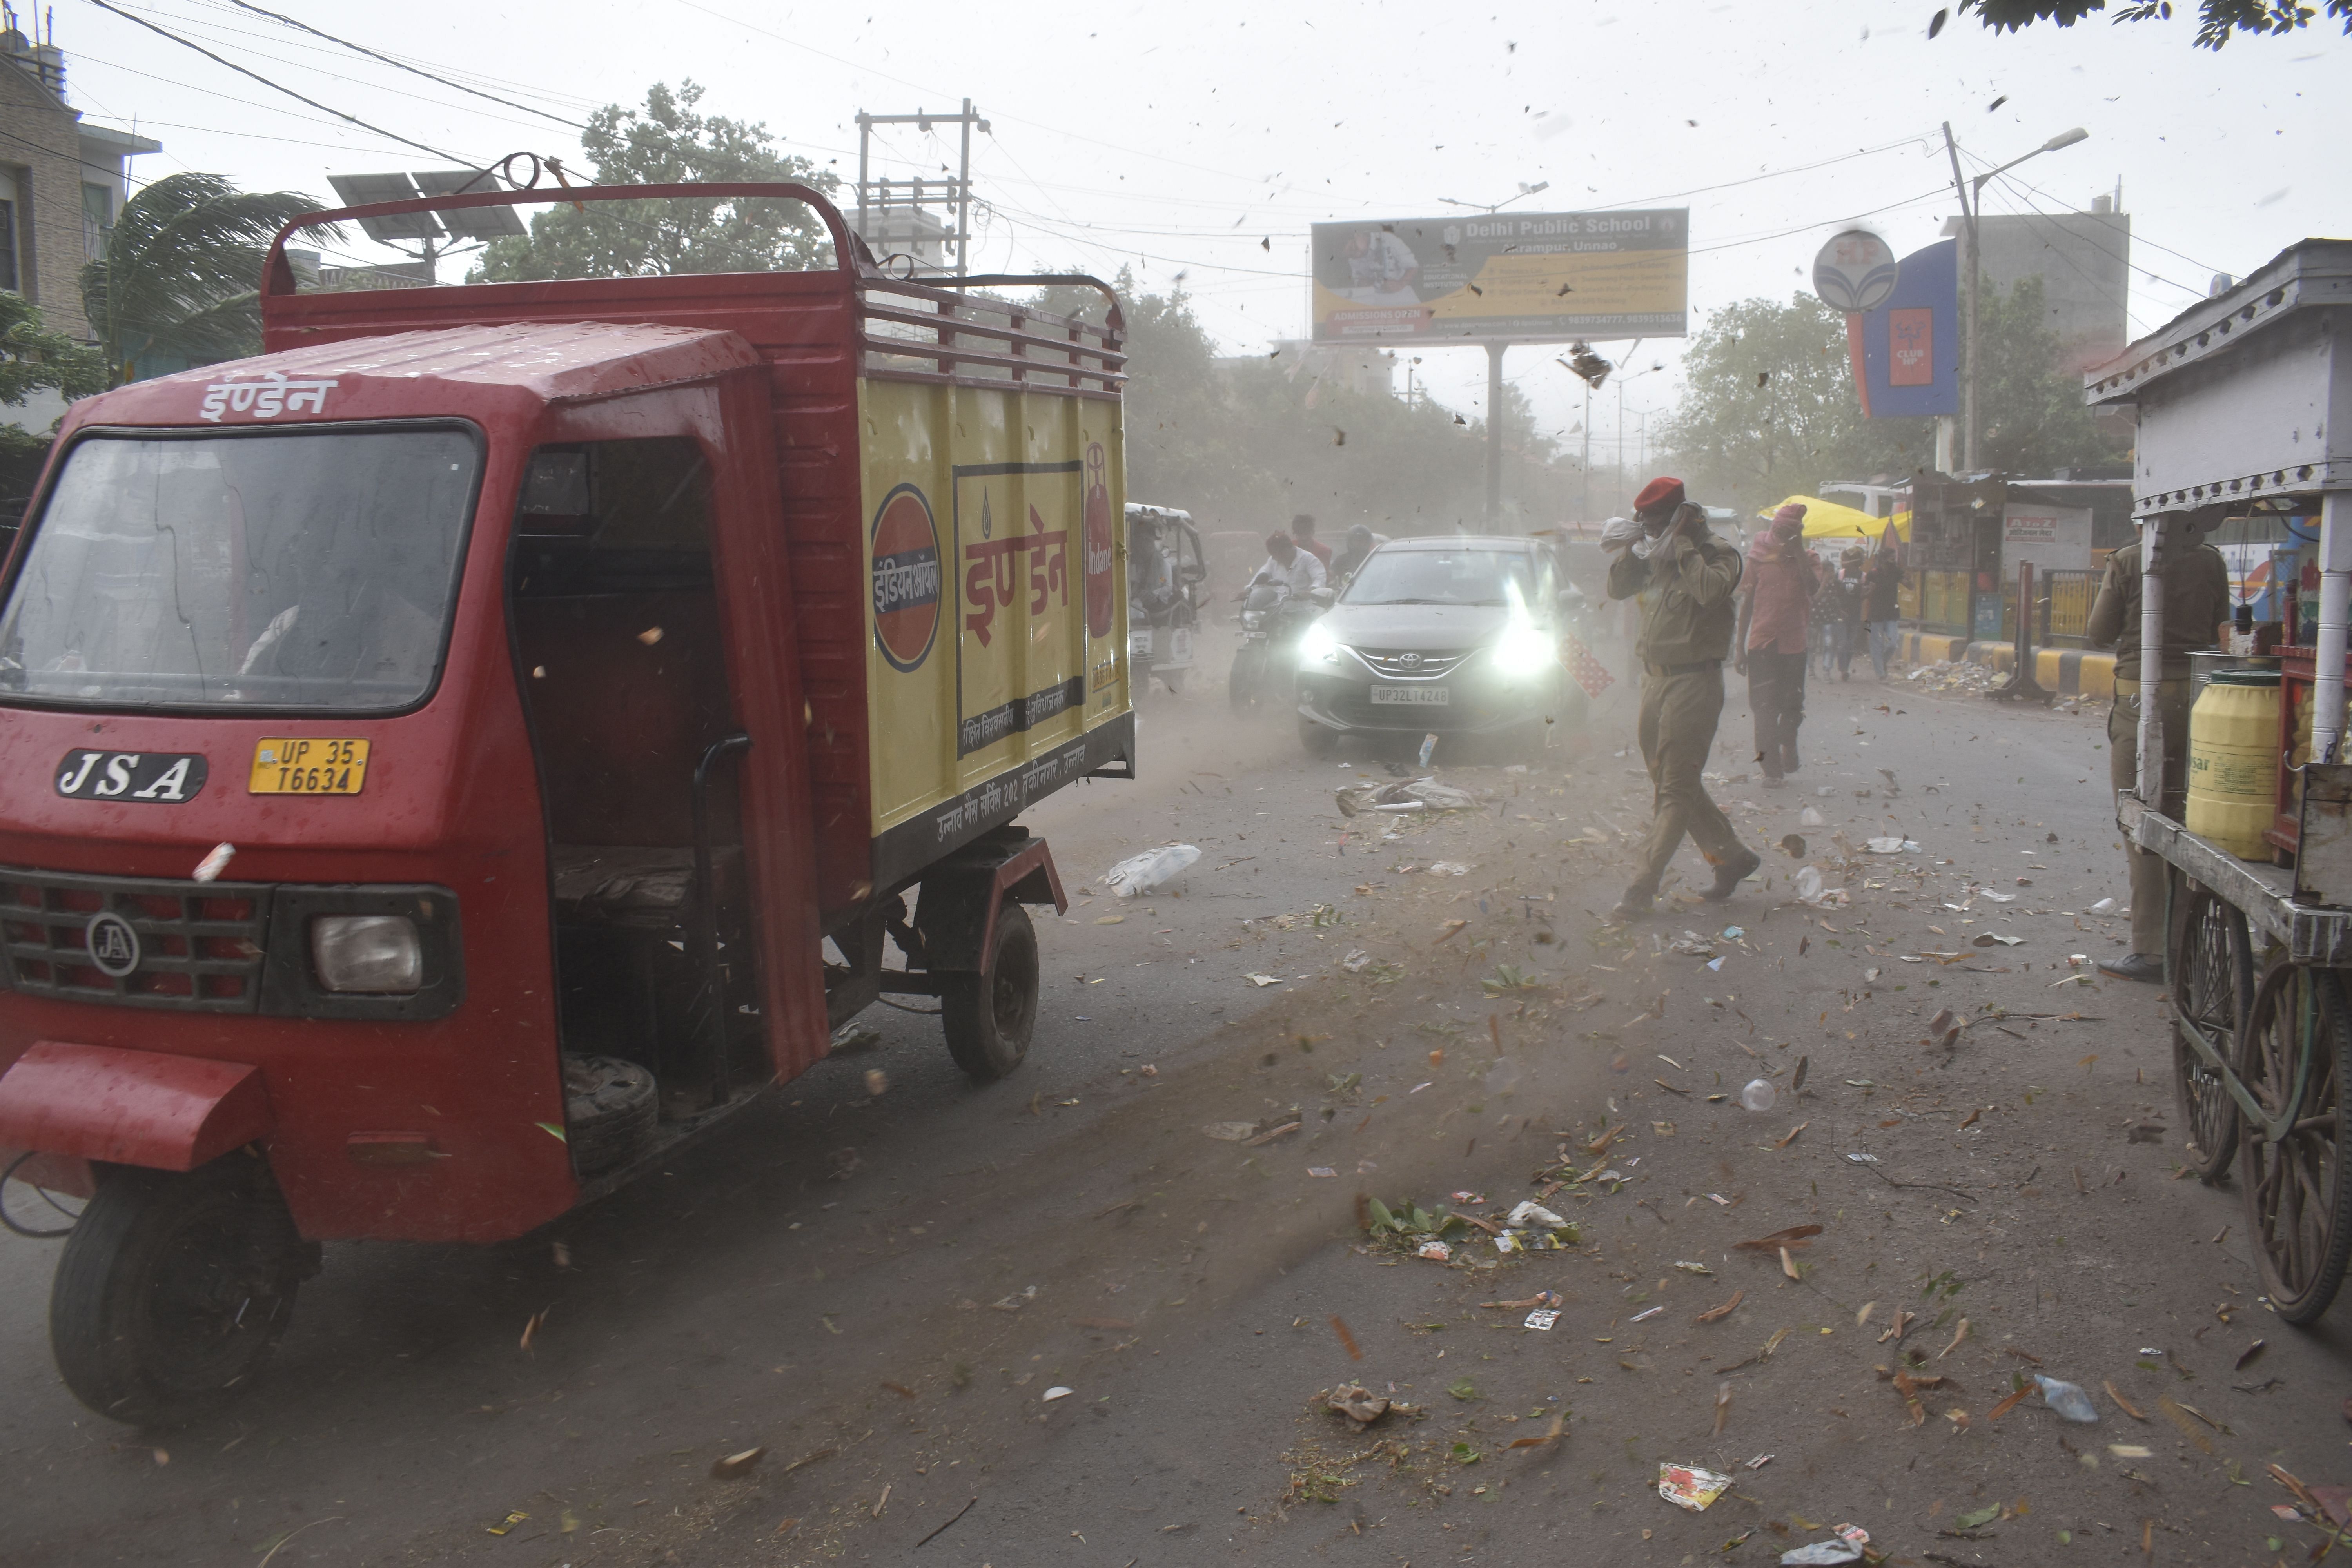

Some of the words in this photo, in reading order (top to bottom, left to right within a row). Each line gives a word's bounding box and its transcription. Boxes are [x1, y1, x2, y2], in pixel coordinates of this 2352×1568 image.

[1466, 221, 1513, 237] Delhi
[1521, 219, 1579, 235] Public
[1586, 216, 1650, 233] School
[1574, 241, 1617, 251] Unnao
[1834, 241, 1879, 265] HP
[1334, 311, 1392, 320] ADMISSIONS
[1395, 310, 1421, 318] OPEN
[1897, 350, 1924, 358] CLUB
[1902, 358, 1918, 366] HP
[2010, 518, 2022, 527] A
[2043, 519, 2052, 527] Z
[1089, 541, 1111, 575] Indane
[1379, 689, 1446, 702] UP32LT4248
[281, 740, 309, 764] UP
[325, 740, 354, 764] 35
[59, 753, 192, 800] JSA
[278, 767, 350, 791] T6634
[937, 806, 963, 842] उन्नाव
[965, 793, 979, 825] गैस
[1004, 779, 1018, 807] 202
[1063, 744, 1086, 774] उन्नाव
